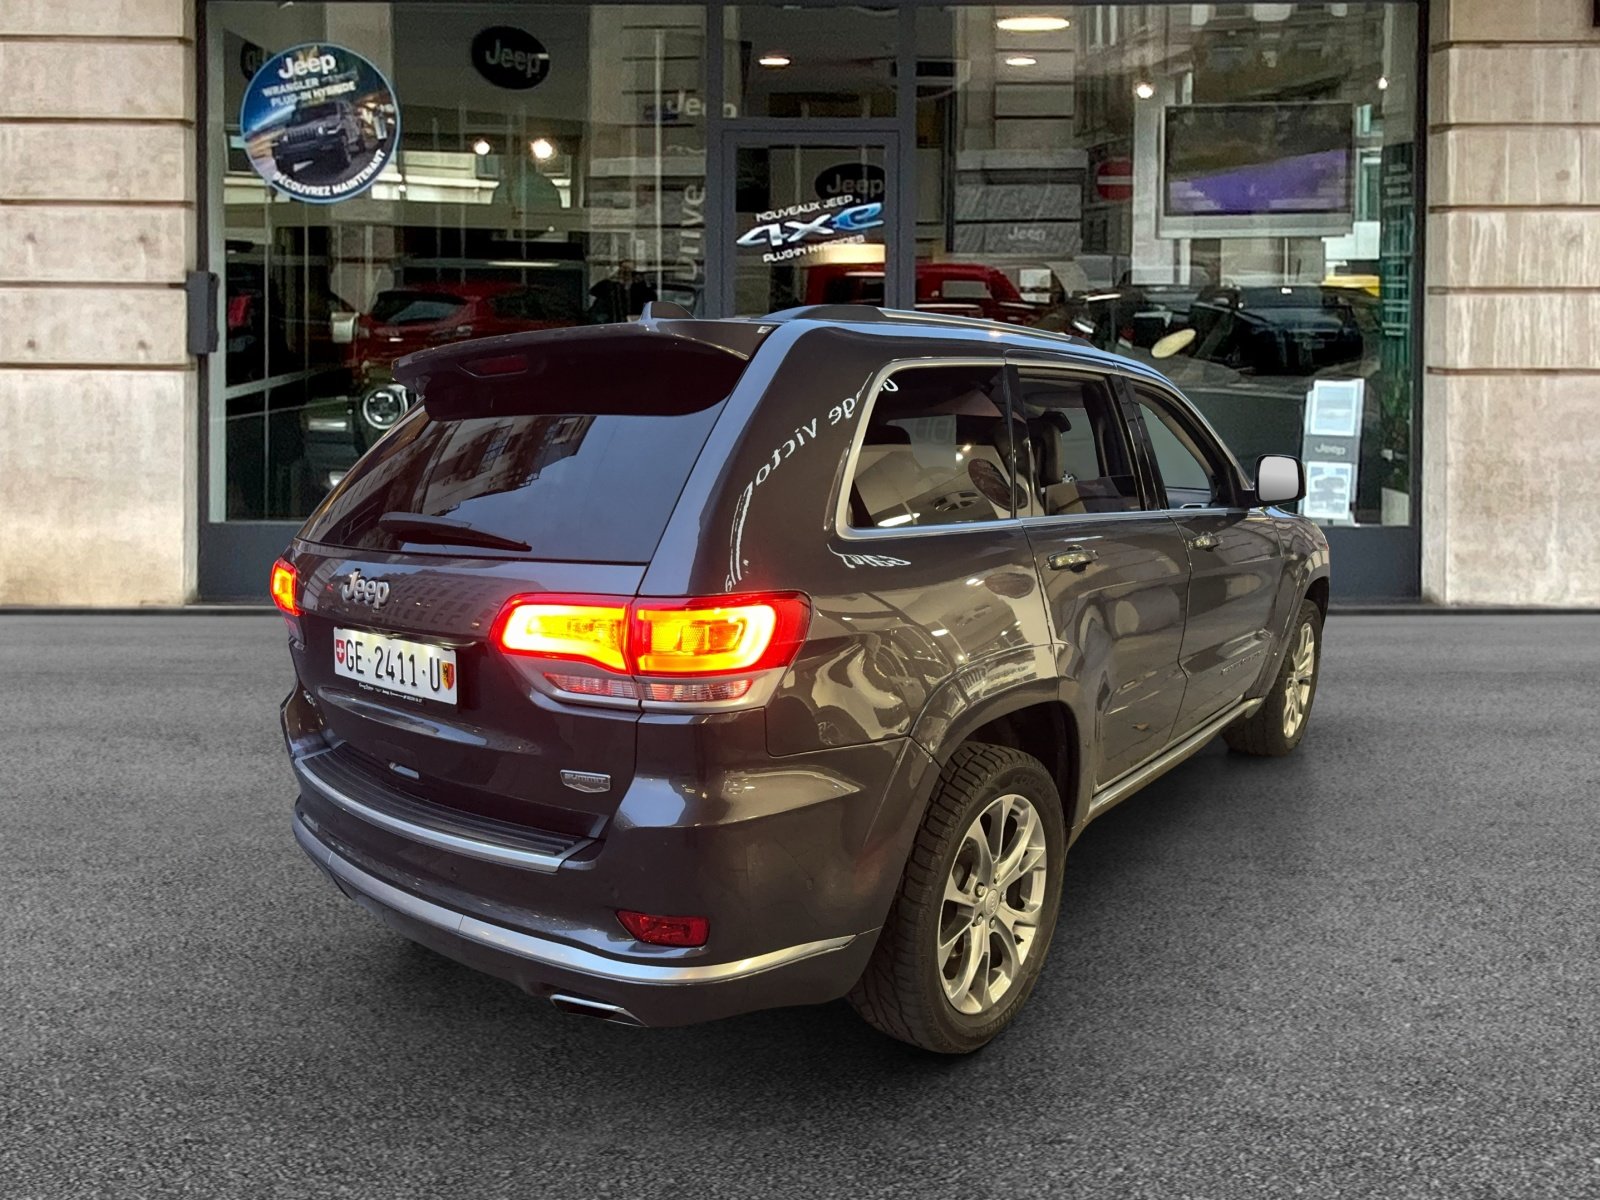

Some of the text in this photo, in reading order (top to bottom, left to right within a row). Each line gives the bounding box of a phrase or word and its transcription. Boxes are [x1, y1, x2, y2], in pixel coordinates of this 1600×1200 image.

[278, 55, 336, 79] Jeep
[485, 38, 540, 78] Jeep
[262, 77, 319, 97] WRANGLER
[272, 149, 386, 196] DÉCOUVREZ MAINTENANT
[827, 174, 884, 199] Jeep
[756, 194, 853, 222] NOUVEAUX JEEP
[341, 571, 390, 609] Jeep
